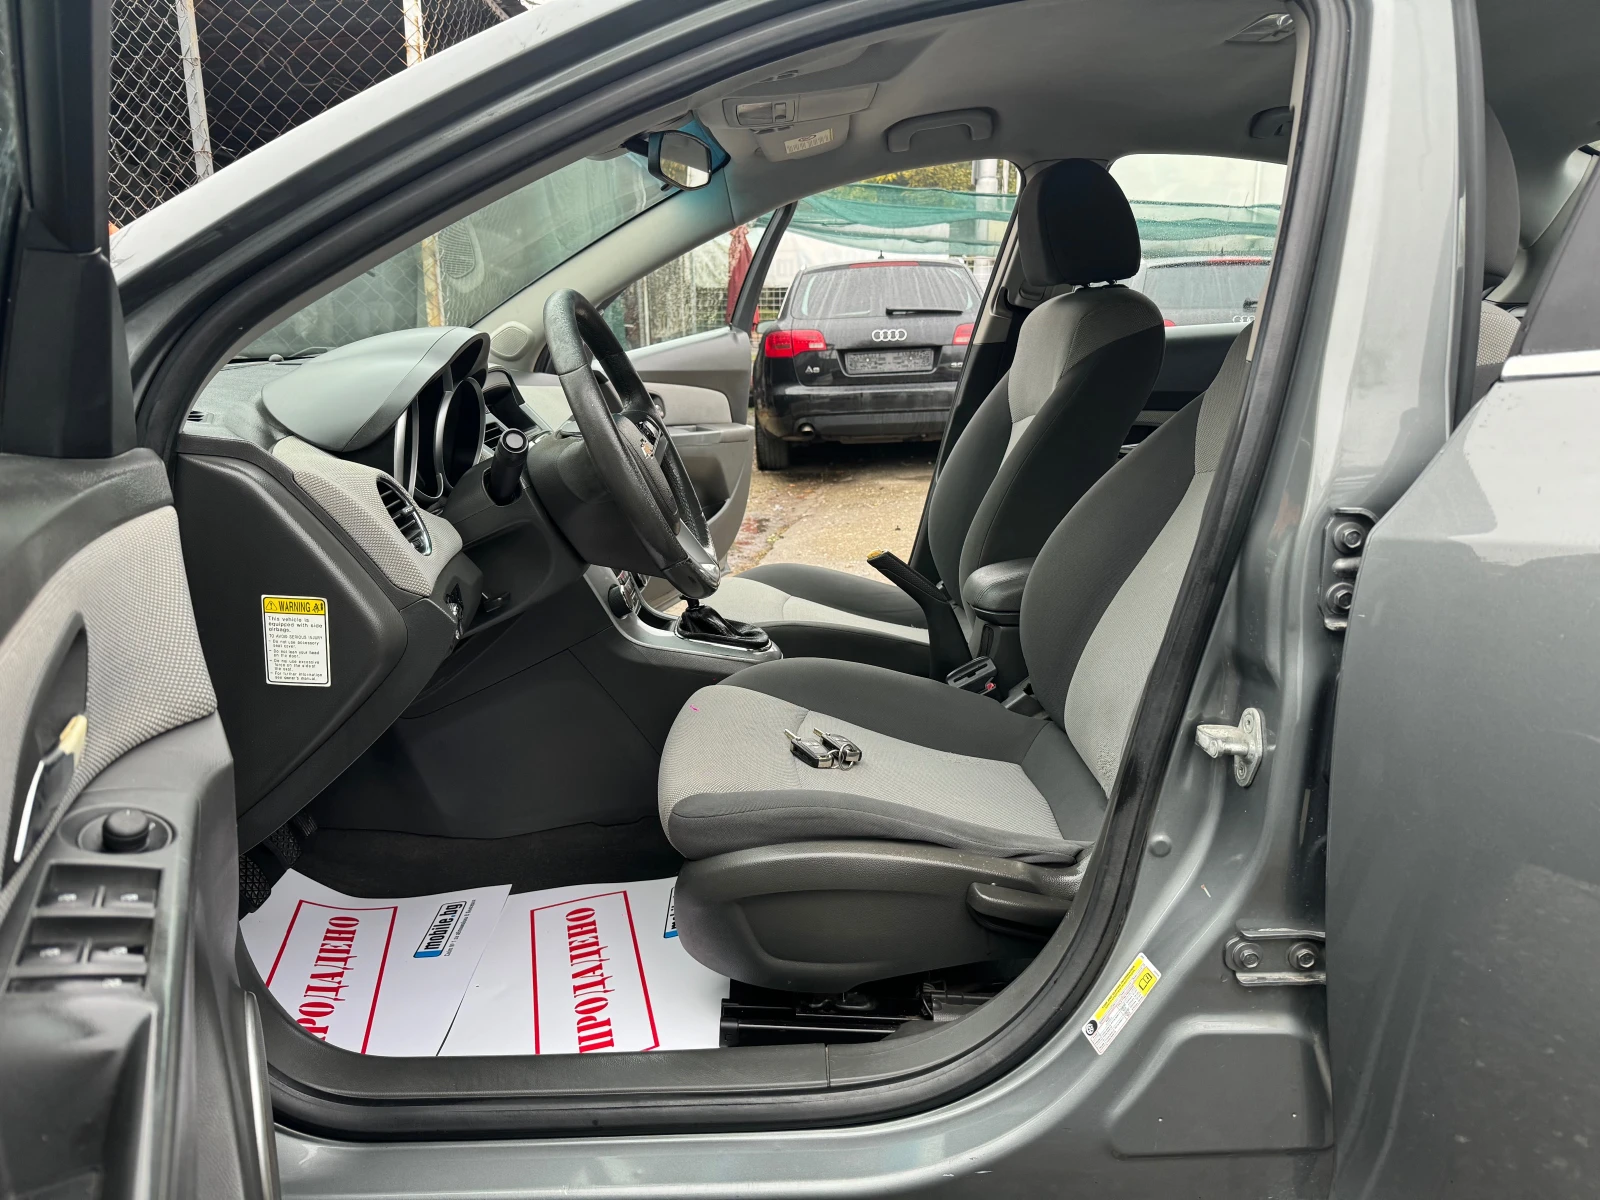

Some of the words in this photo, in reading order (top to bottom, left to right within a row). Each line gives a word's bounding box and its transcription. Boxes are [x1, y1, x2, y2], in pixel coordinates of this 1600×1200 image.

[278, 600, 311, 612] WARNING
[424, 903, 463, 950] mobile.bg
[295, 916, 360, 1041] РОДАДЕНО
[565, 907, 615, 1054] ПРОДАДЕНО
